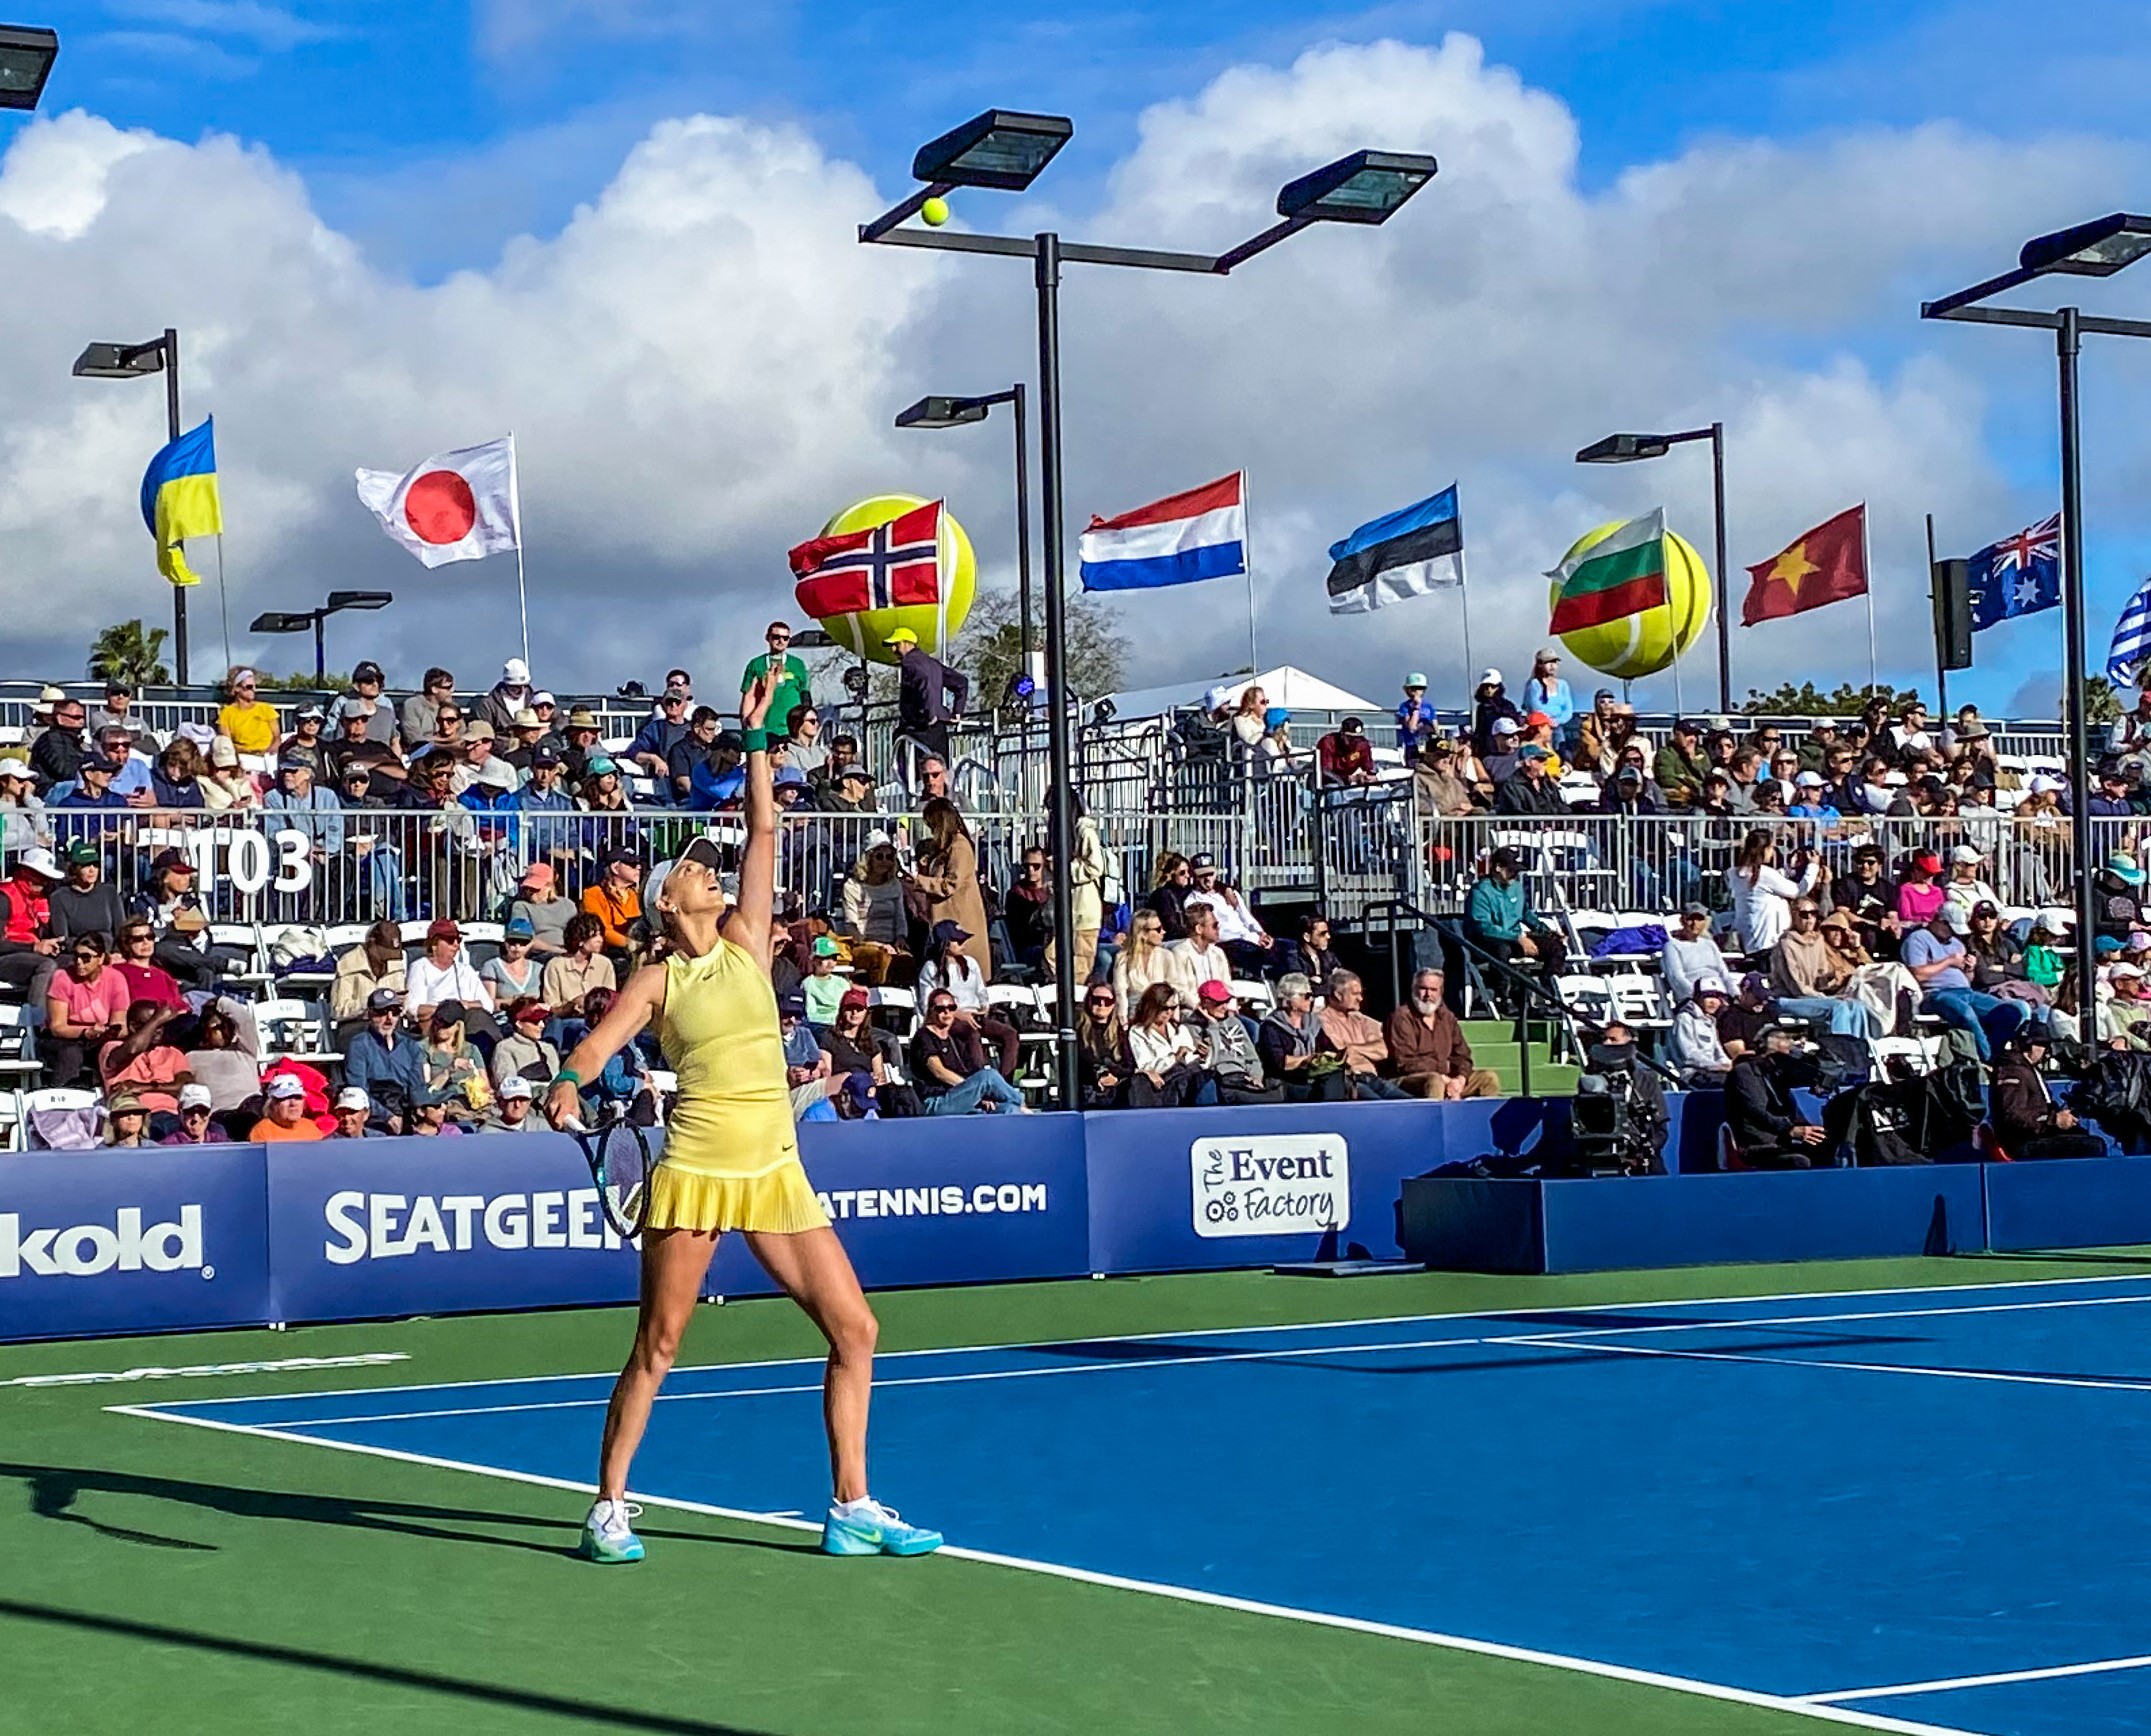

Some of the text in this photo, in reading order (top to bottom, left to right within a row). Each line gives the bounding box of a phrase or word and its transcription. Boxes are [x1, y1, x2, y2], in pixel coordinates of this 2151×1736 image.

[189, 828, 312, 893] 103
[1203, 1149, 1224, 1193] The
[1228, 1149, 1333, 1181] Event
[1244, 1187, 1333, 1227] Factory
